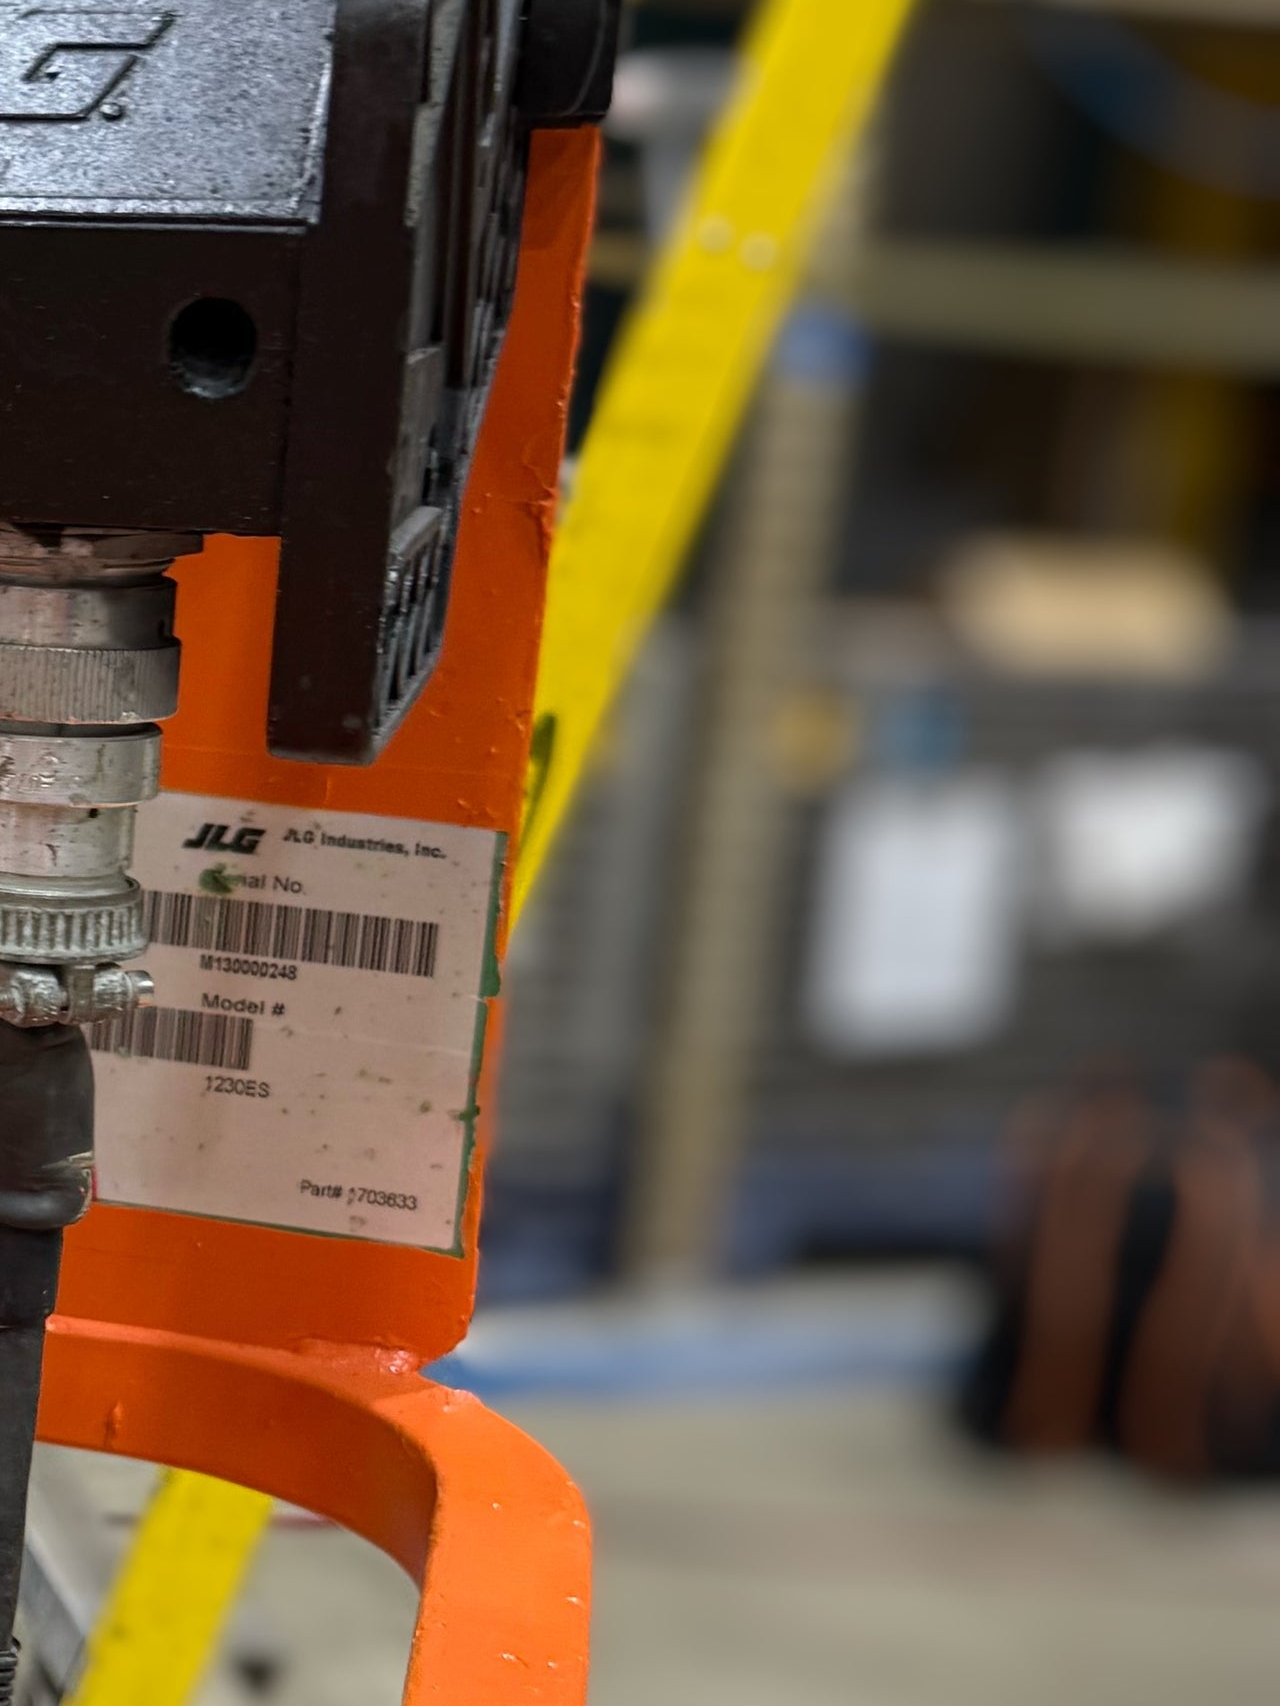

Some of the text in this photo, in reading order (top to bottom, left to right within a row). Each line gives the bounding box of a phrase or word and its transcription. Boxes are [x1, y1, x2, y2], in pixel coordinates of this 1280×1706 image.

[182, 823, 267, 855] JLG
[281, 826, 447, 859] JLG Industries, Inc.
[271, 874, 304, 894] No.
[201, 991, 286, 1017] Model #
[204, 1074, 271, 1099] 1230ES
[298, 1178, 344, 1199] Part#
